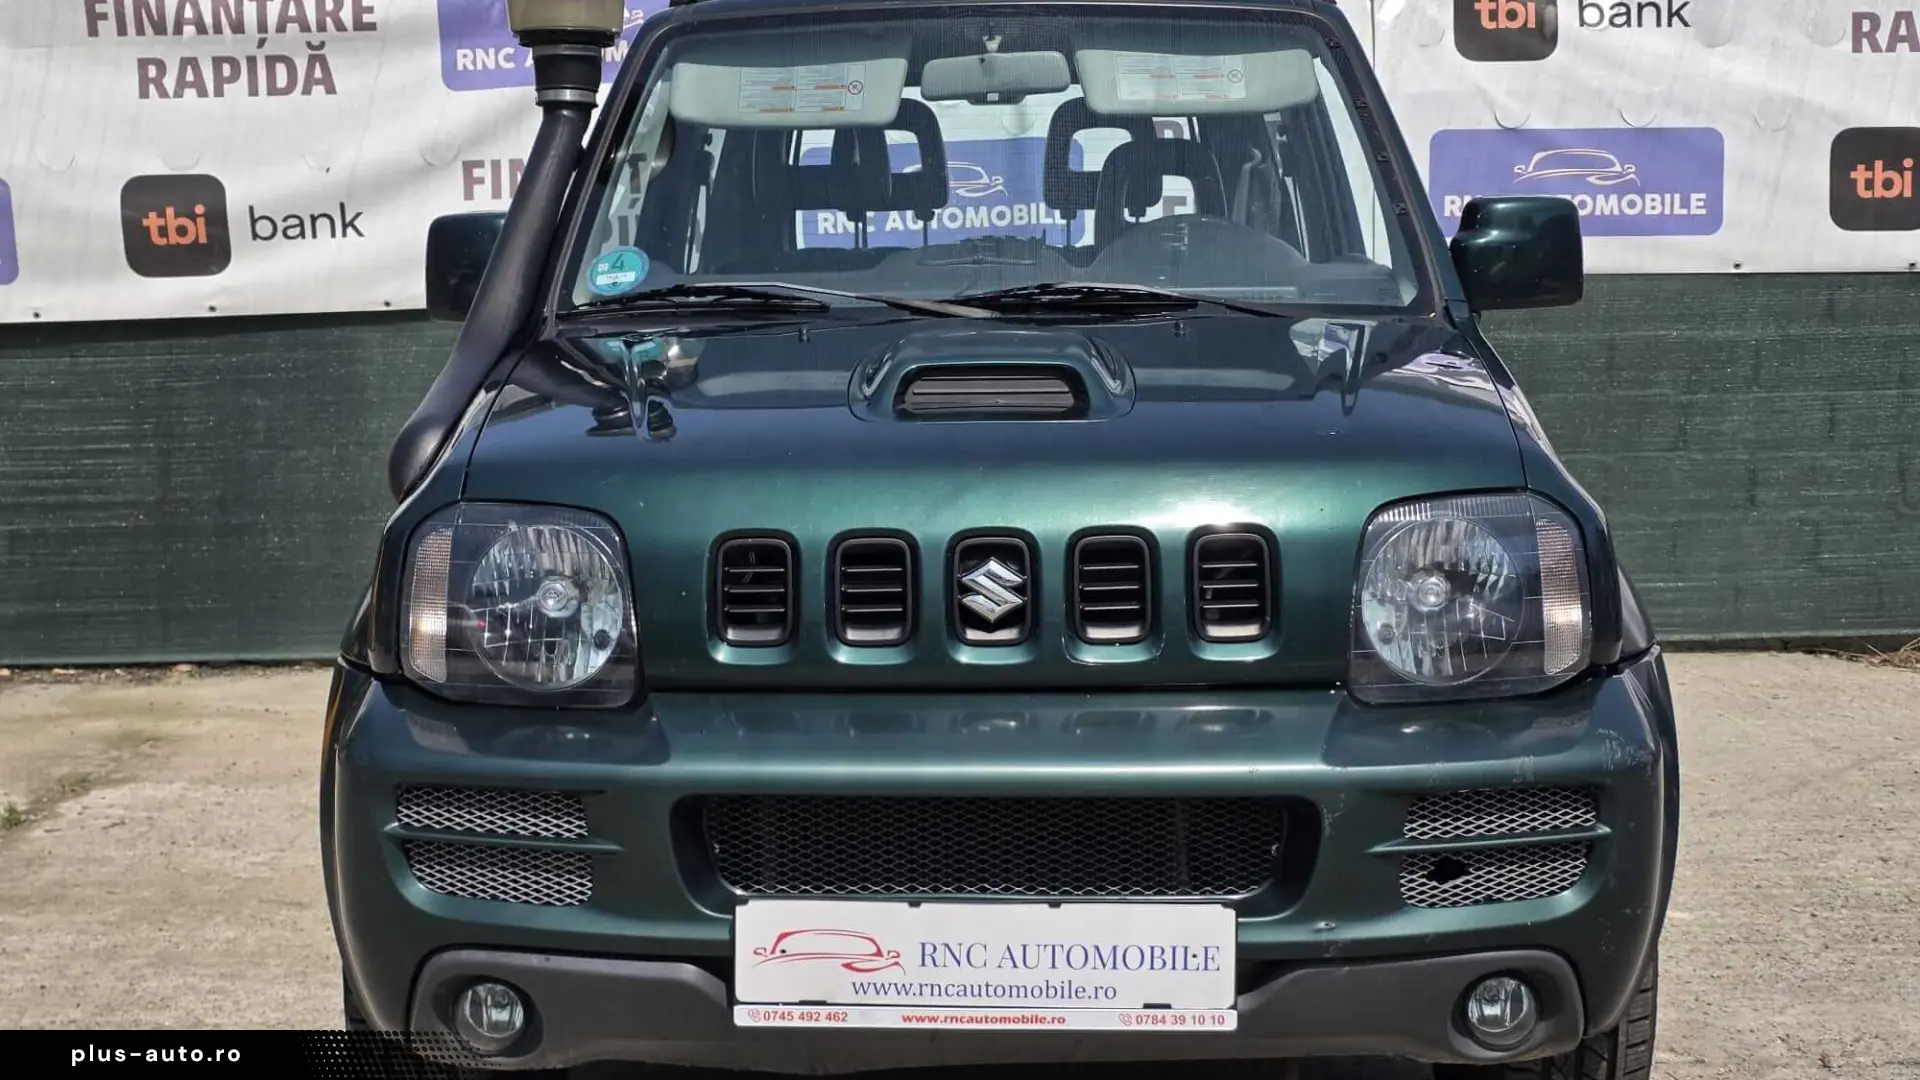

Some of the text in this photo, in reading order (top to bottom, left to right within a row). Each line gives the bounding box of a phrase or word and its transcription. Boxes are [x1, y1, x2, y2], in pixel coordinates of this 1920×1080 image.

[1474, 0, 1691, 30] tbi bank
[137, 40, 337, 99] RAPIDĂ
[456, 48, 515, 71] RNC
[1850, 158, 1914, 198] tbi
[1558, 193, 1707, 216] OMOBILE
[142, 202, 364, 246] tbi bank
[611, 252, 626, 272] 4
[919, 941, 1221, 972] RNC AUTOMOBILE
[852, 979, 1117, 1001] www.rncautomobile.ro
[763, 1010, 849, 1023] 0745 492 462
[902, 1013, 1066, 1025] www.rncautomobile.ro
[1135, 1014, 1225, 1026] 0784 39 10 10
